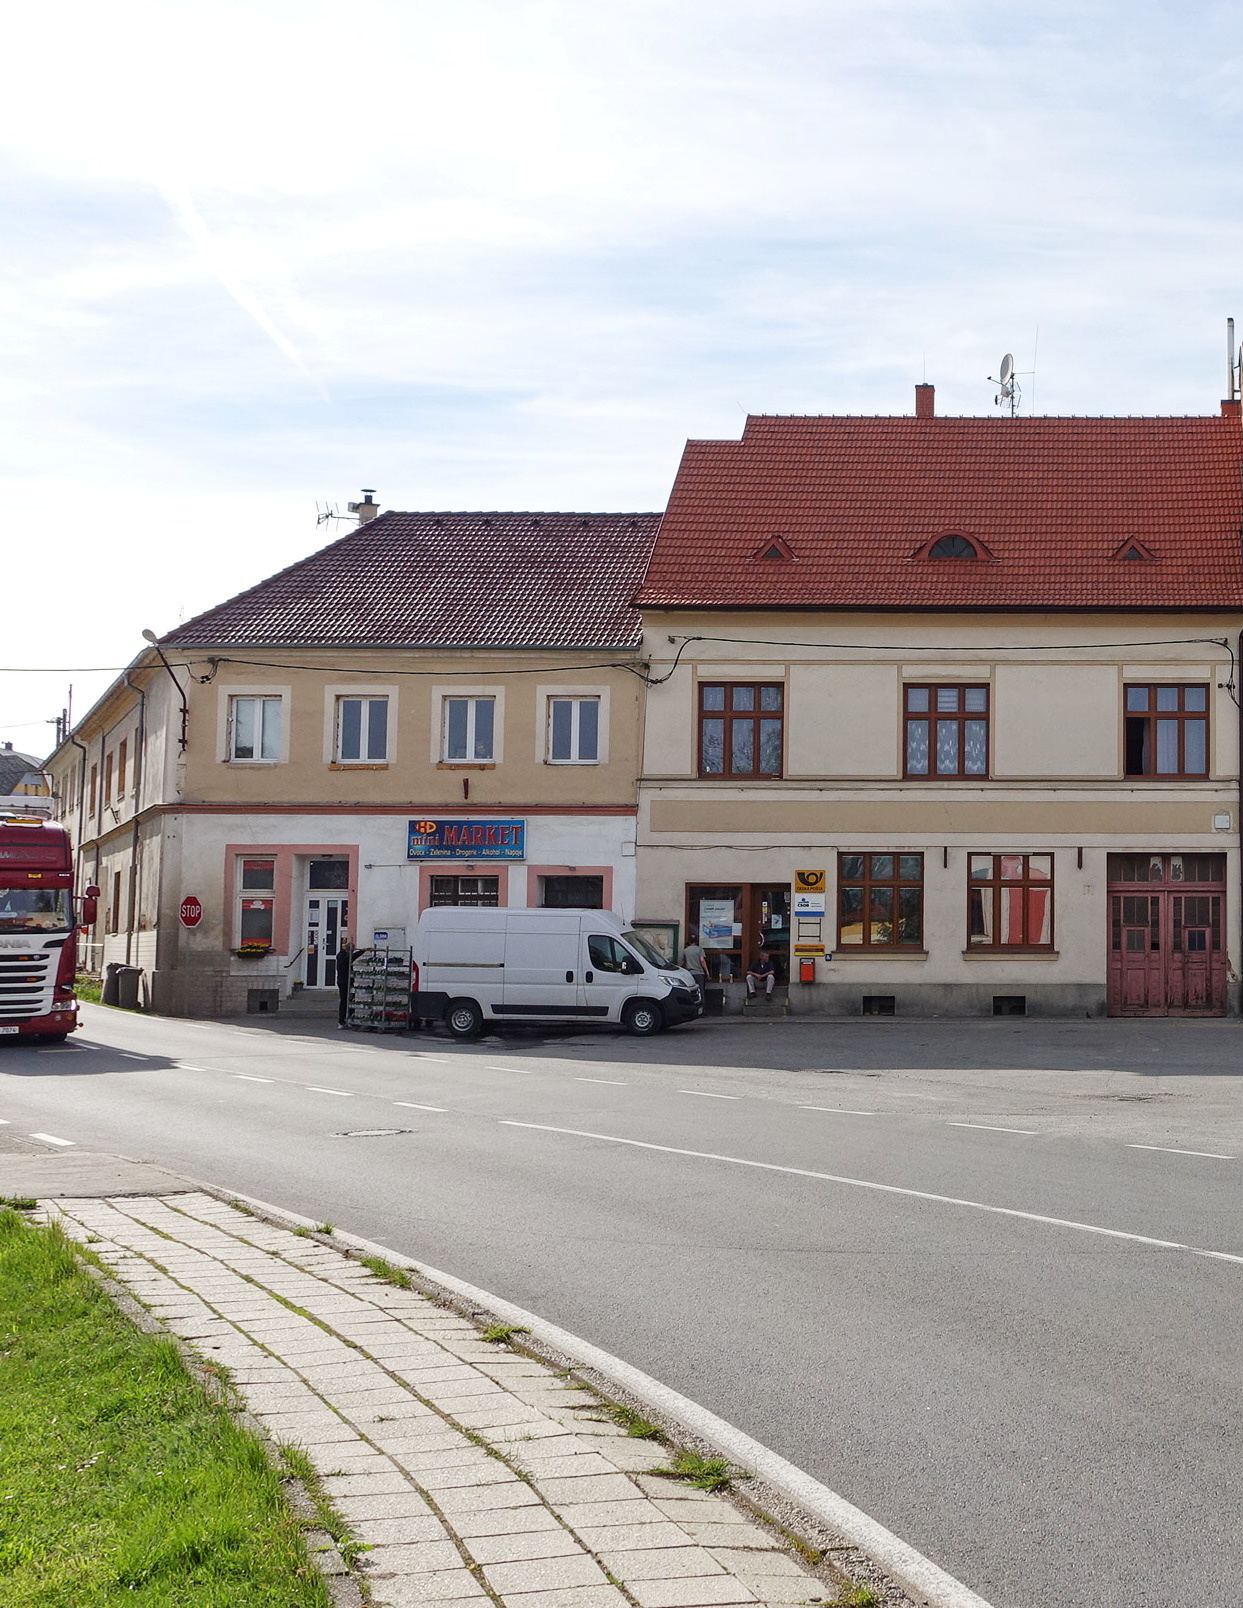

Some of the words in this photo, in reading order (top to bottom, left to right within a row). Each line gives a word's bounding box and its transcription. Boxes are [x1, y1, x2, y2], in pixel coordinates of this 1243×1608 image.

[411, 834, 439, 845] mini
[443, 825, 522, 845] MARKET
[181, 905, 200, 917] STOP
